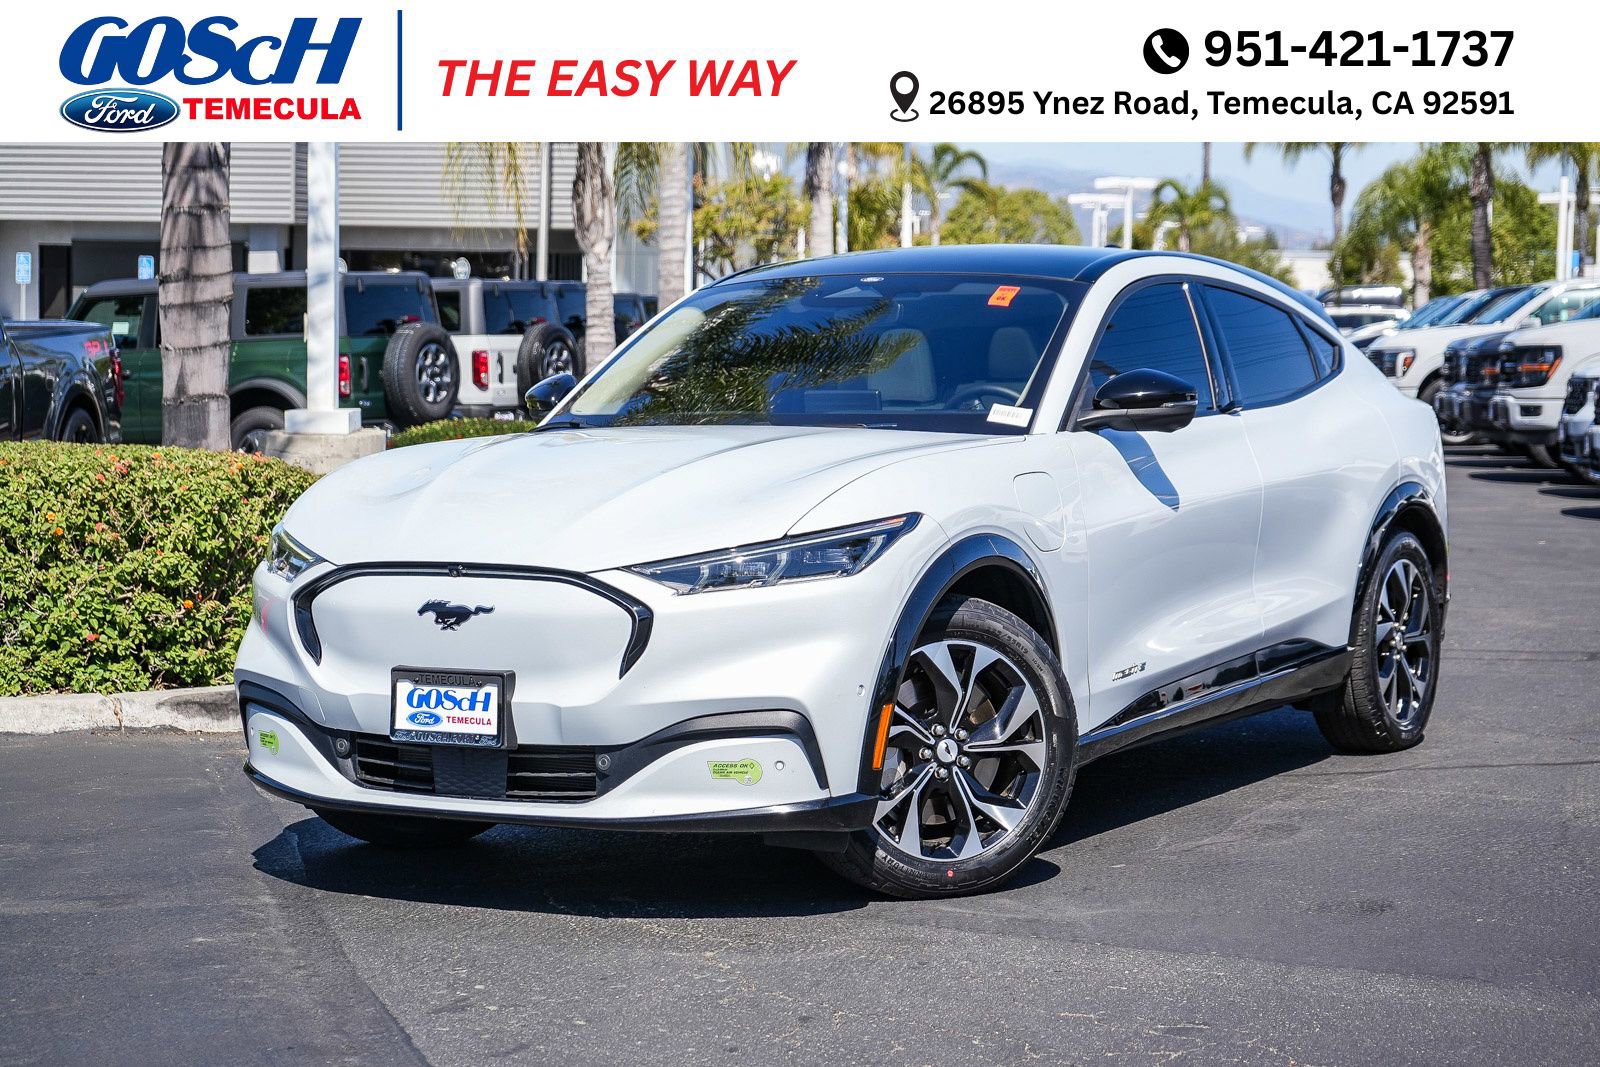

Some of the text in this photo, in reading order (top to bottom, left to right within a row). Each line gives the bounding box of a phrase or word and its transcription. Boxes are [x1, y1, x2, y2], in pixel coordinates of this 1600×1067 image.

[419, 673, 476, 686] TEMECULA
[414, 713, 436, 726] Ford
[446, 715, 492, 725] TEMECULA
